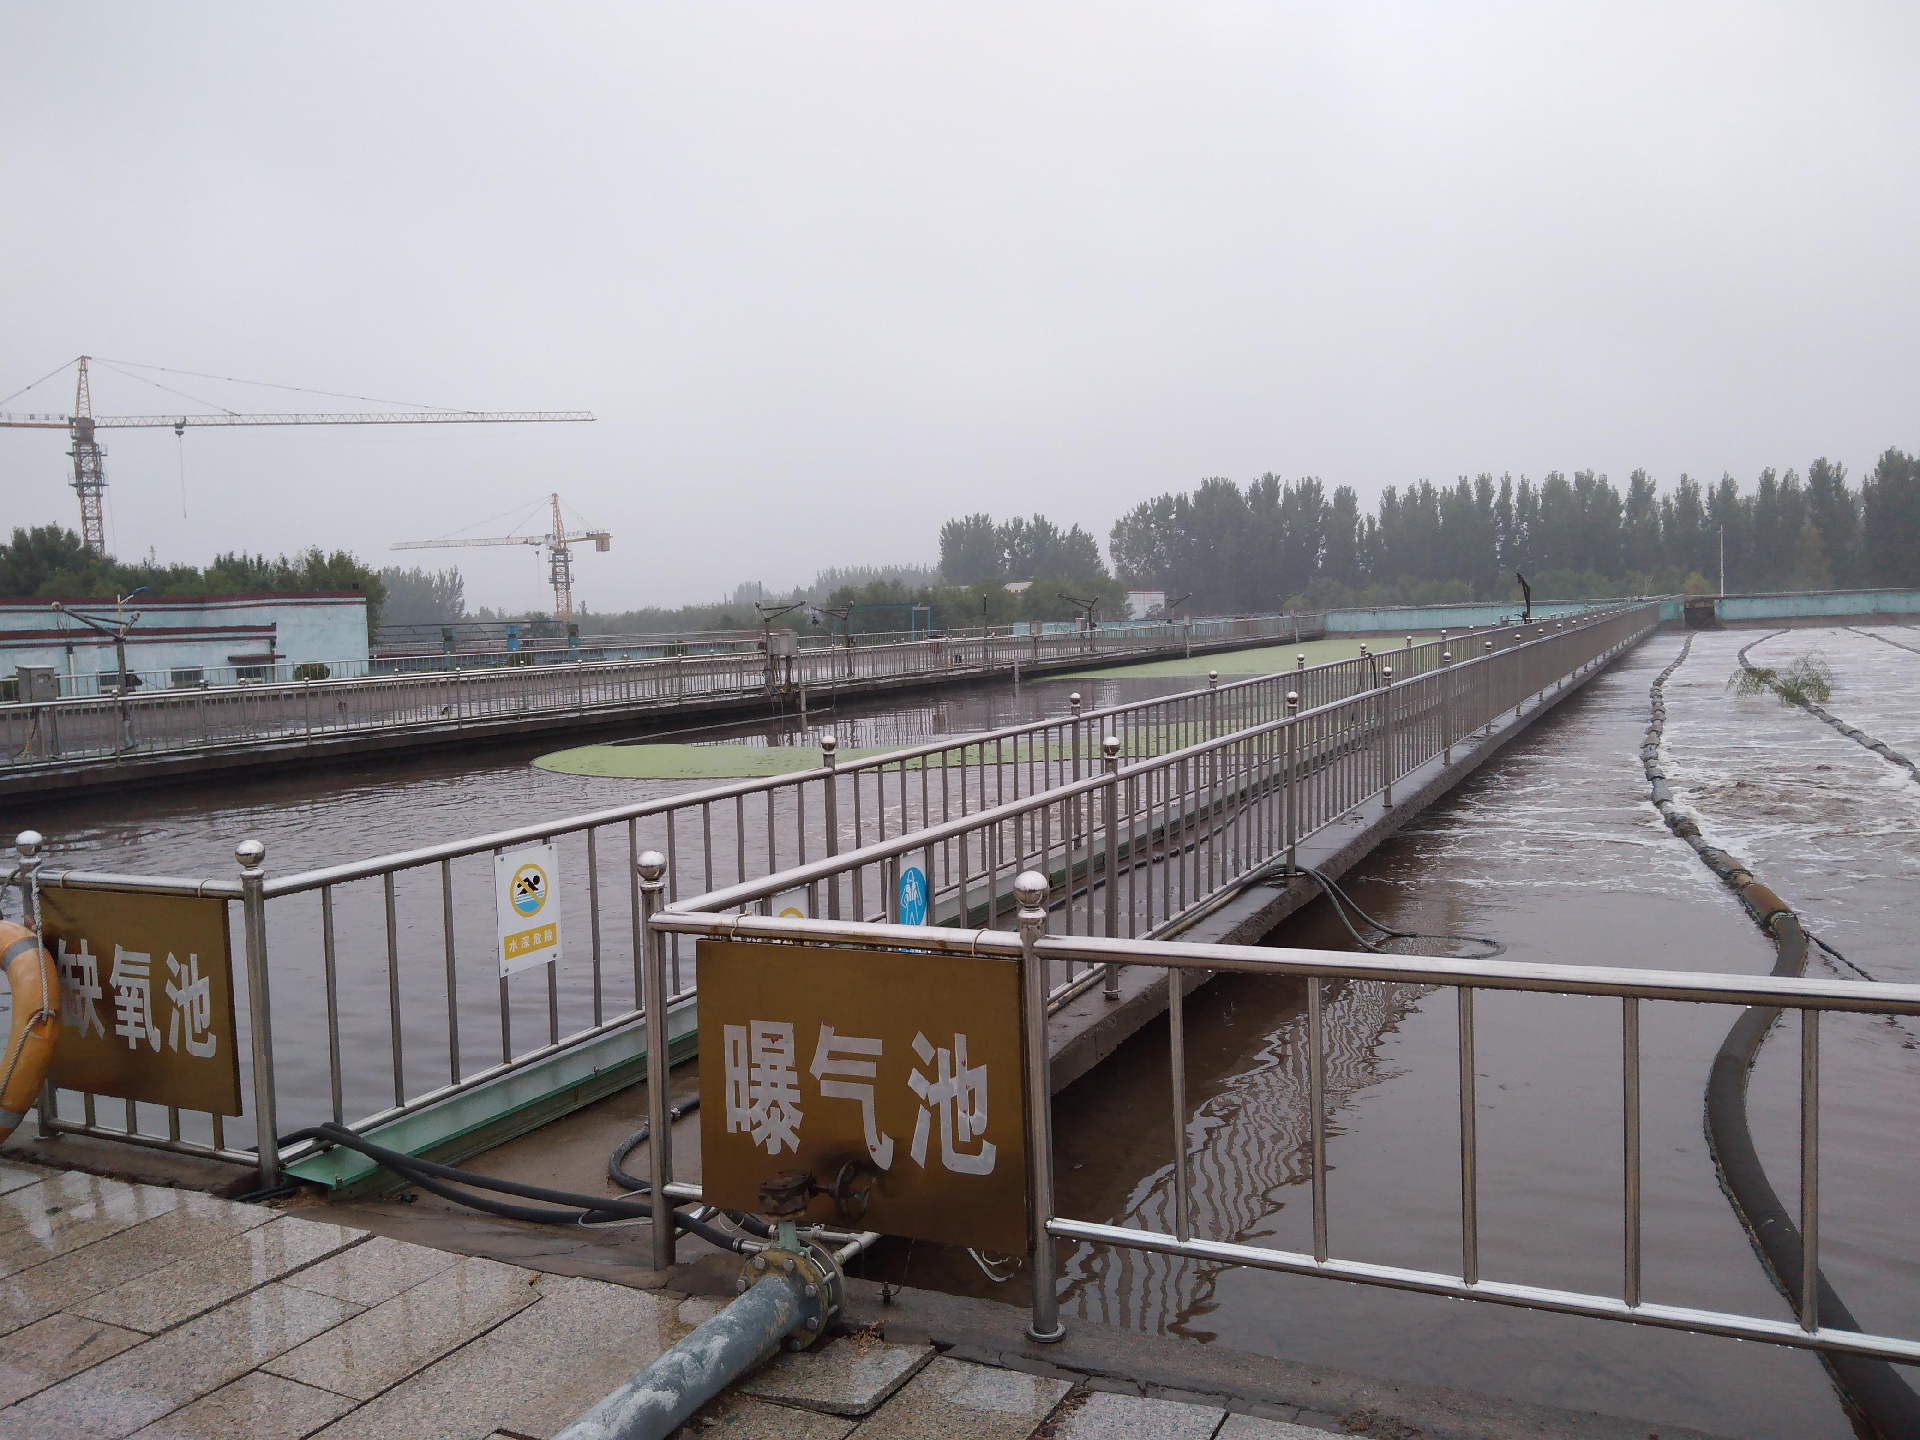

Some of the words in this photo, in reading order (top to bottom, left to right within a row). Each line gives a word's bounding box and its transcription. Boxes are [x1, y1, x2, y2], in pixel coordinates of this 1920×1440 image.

[57, 938, 216, 1058] 缺氧池
[509, 929, 552, 952] 水深危险
[723, 1020, 996, 1176] 曝气池
